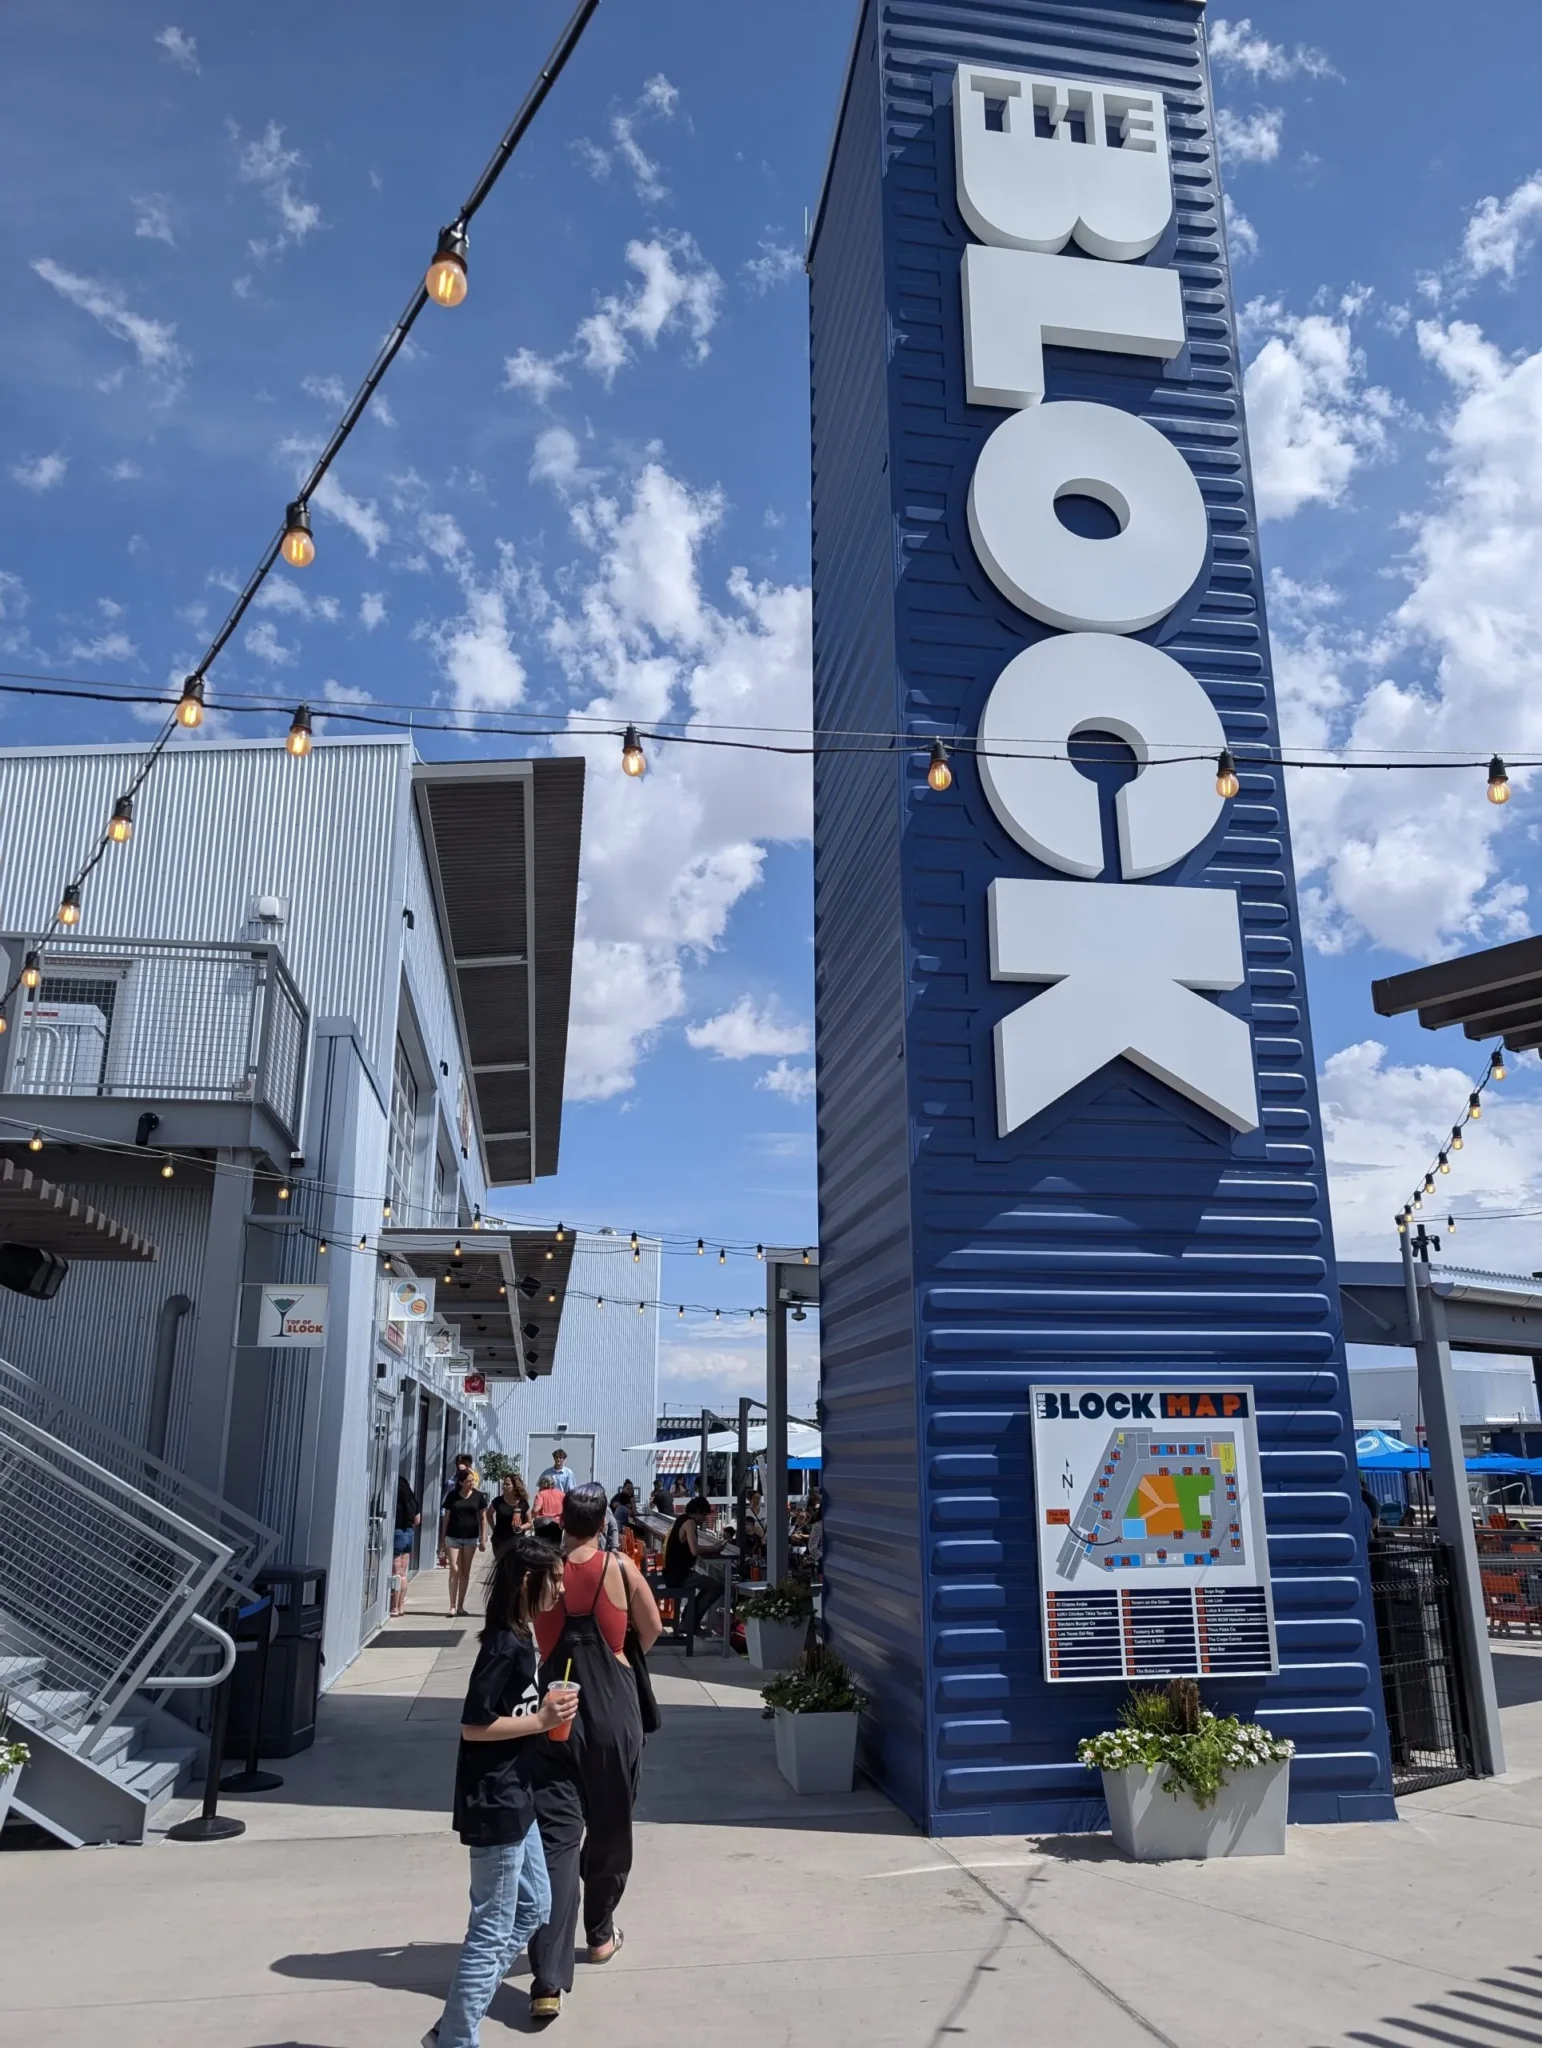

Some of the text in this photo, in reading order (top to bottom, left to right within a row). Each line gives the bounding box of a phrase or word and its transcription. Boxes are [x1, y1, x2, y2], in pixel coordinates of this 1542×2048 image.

[970, 74, 1158, 153] THE
[952, 63, 1259, 1138] BLOCK
[286, 1325, 324, 1333] BLOCK
[1036, 1392, 1241, 1419] BLOCK MAP
[1037, 1393, 1047, 1418] THE
[1062, 1474, 1073, 1488] N
